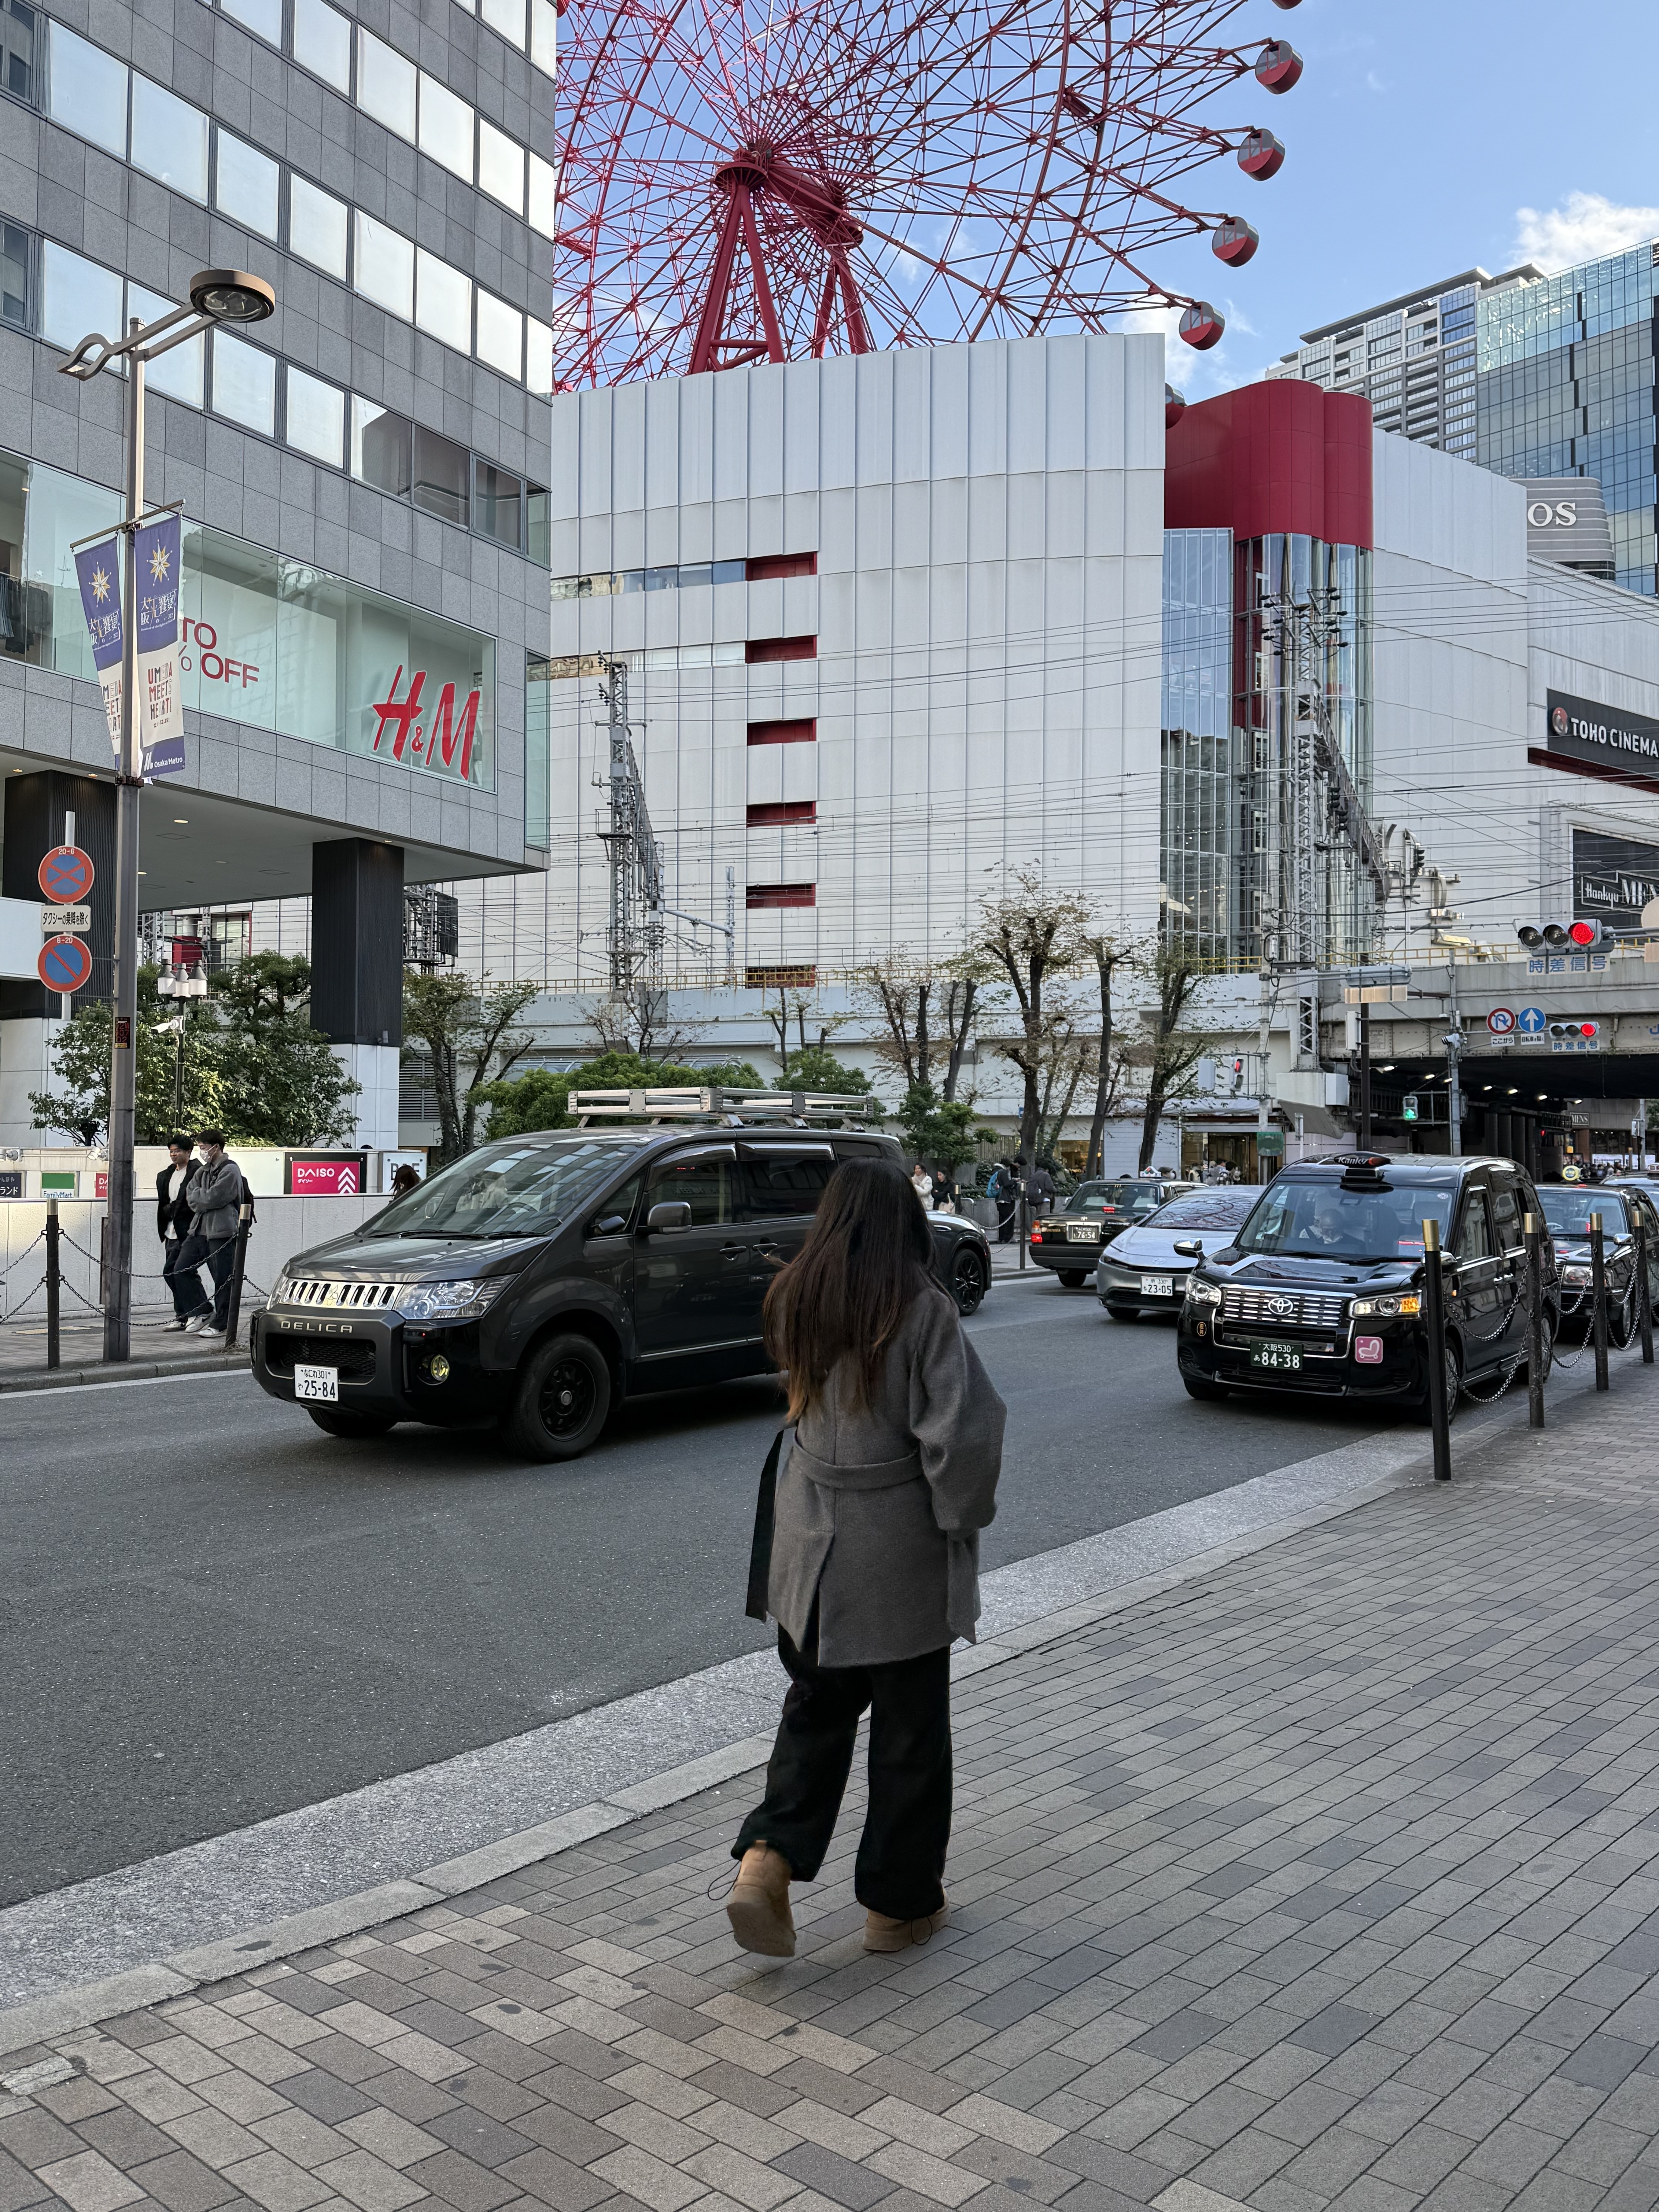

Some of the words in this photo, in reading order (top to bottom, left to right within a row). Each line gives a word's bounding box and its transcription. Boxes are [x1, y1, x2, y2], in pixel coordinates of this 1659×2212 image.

[1527, 502, 1577, 527] OS
[148, 661, 172, 685] UMEDA
[201, 653, 259, 688] OFF
[103, 680, 122, 701] MEDA
[373, 665, 480, 781] H&M
[1571, 717, 1607, 744] TOHO
[1610, 728, 1659, 758] CINEMA
[154, 759, 168, 768] Osaka
[1585, 883, 1619, 908] Hankyu
[43, 912, 88, 926] タクシーの乗降を除く
[1529, 955, 1607, 973] 時差信号
[1553, 1040, 1599, 1051] 時差信号
[297, 1168, 335, 1177] DAISO
[1148, 1284, 1172, 1294] 23-05
[281, 1321, 352, 1333] DELICA
[1262, 1352, 1300, 1369] 84-38
[298, 1382, 303, 1391] や
[304, 1380, 336, 1398] 25-84
